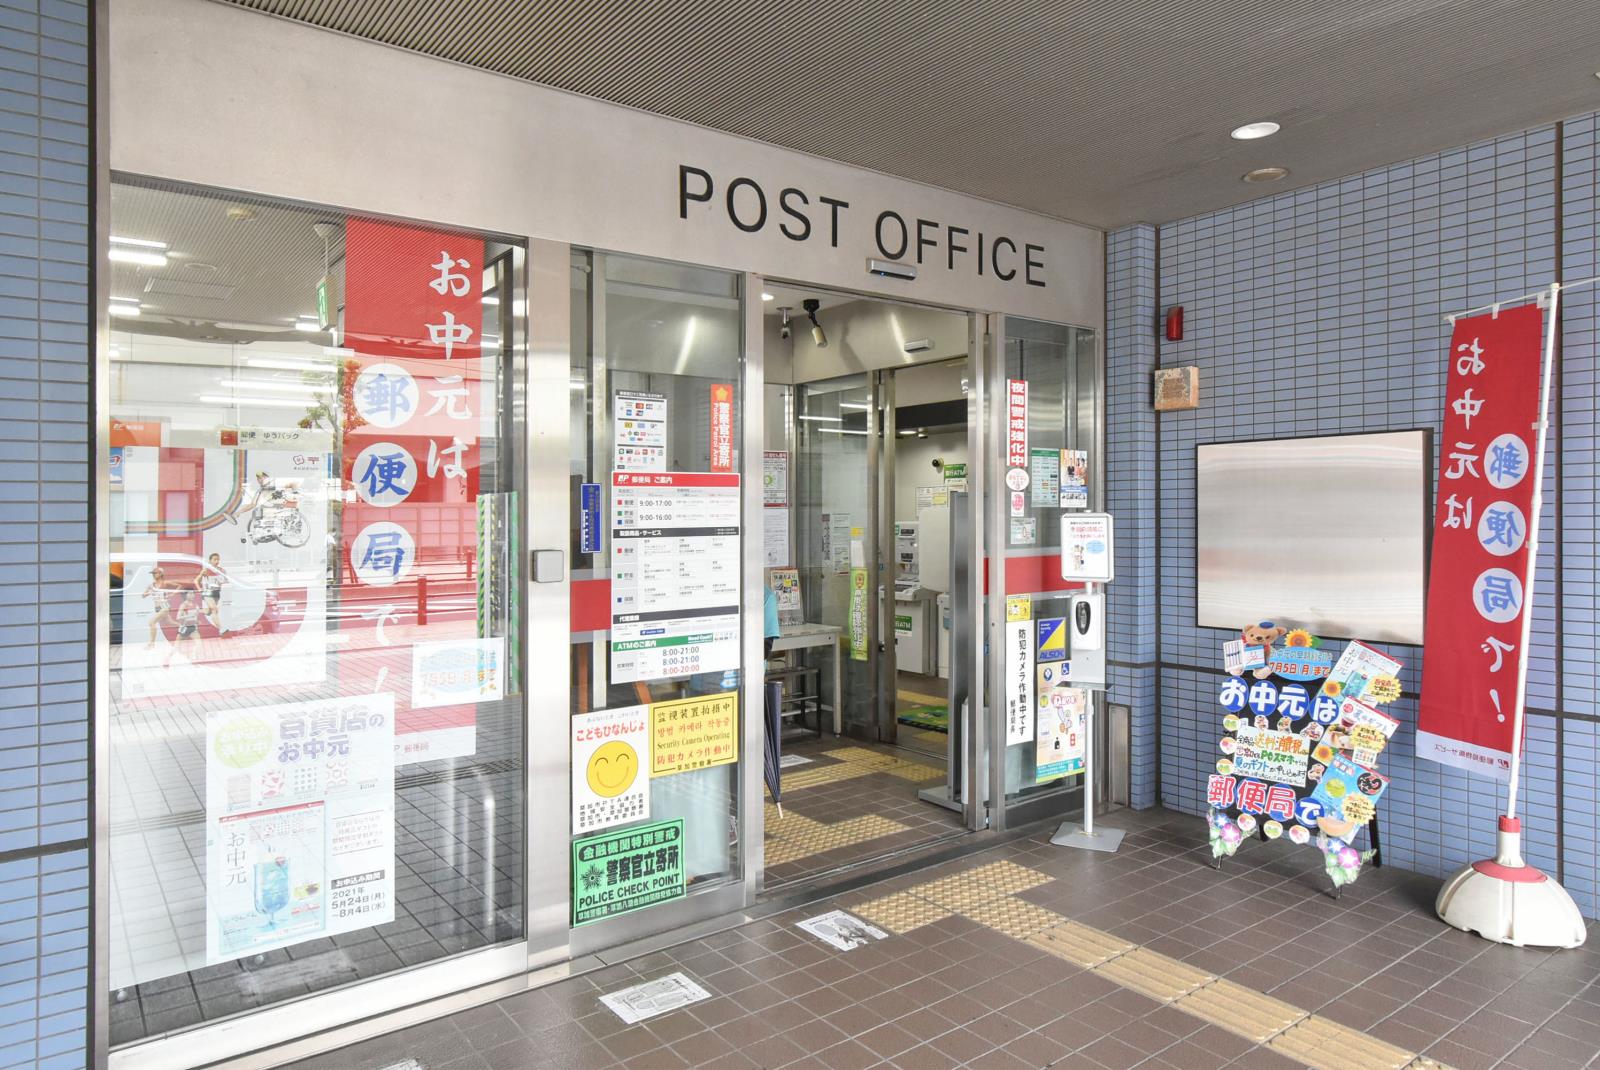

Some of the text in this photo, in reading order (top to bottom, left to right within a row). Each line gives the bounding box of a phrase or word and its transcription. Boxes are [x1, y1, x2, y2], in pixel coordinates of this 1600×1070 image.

[679, 164, 1047, 288] POST OFFICE
[424, 250, 473, 481] お中元は
[654, 475, 673, 485] ご案内
[639, 499, 673, 507] 9:00-17:00
[639, 513, 673, 521] 9:00-16:00
[617, 639, 658, 651] ATMのご案内
[662, 646, 700, 656] 8:00-21:00
[1039, 649, 1065, 661] ALSOK
[662, 655, 700, 666] 8:00-21:00
[1018, 628, 1027, 737] 防犯カメラ作動中です
[1220, 677, 1338, 724] お中元は
[576, 720, 645, 742] こどもひなんじょ
[657, 732, 730, 750] Security Camera Operating
[278, 734, 350, 763] お中元
[1207, 773, 1323, 824] 郵便局で
[227, 832, 248, 888] お中元
[606, 844, 679, 887] 警察官立寄所
[332, 886, 366, 900] 2021年
[579, 873, 681, 909] POLICE CHECK POINT
